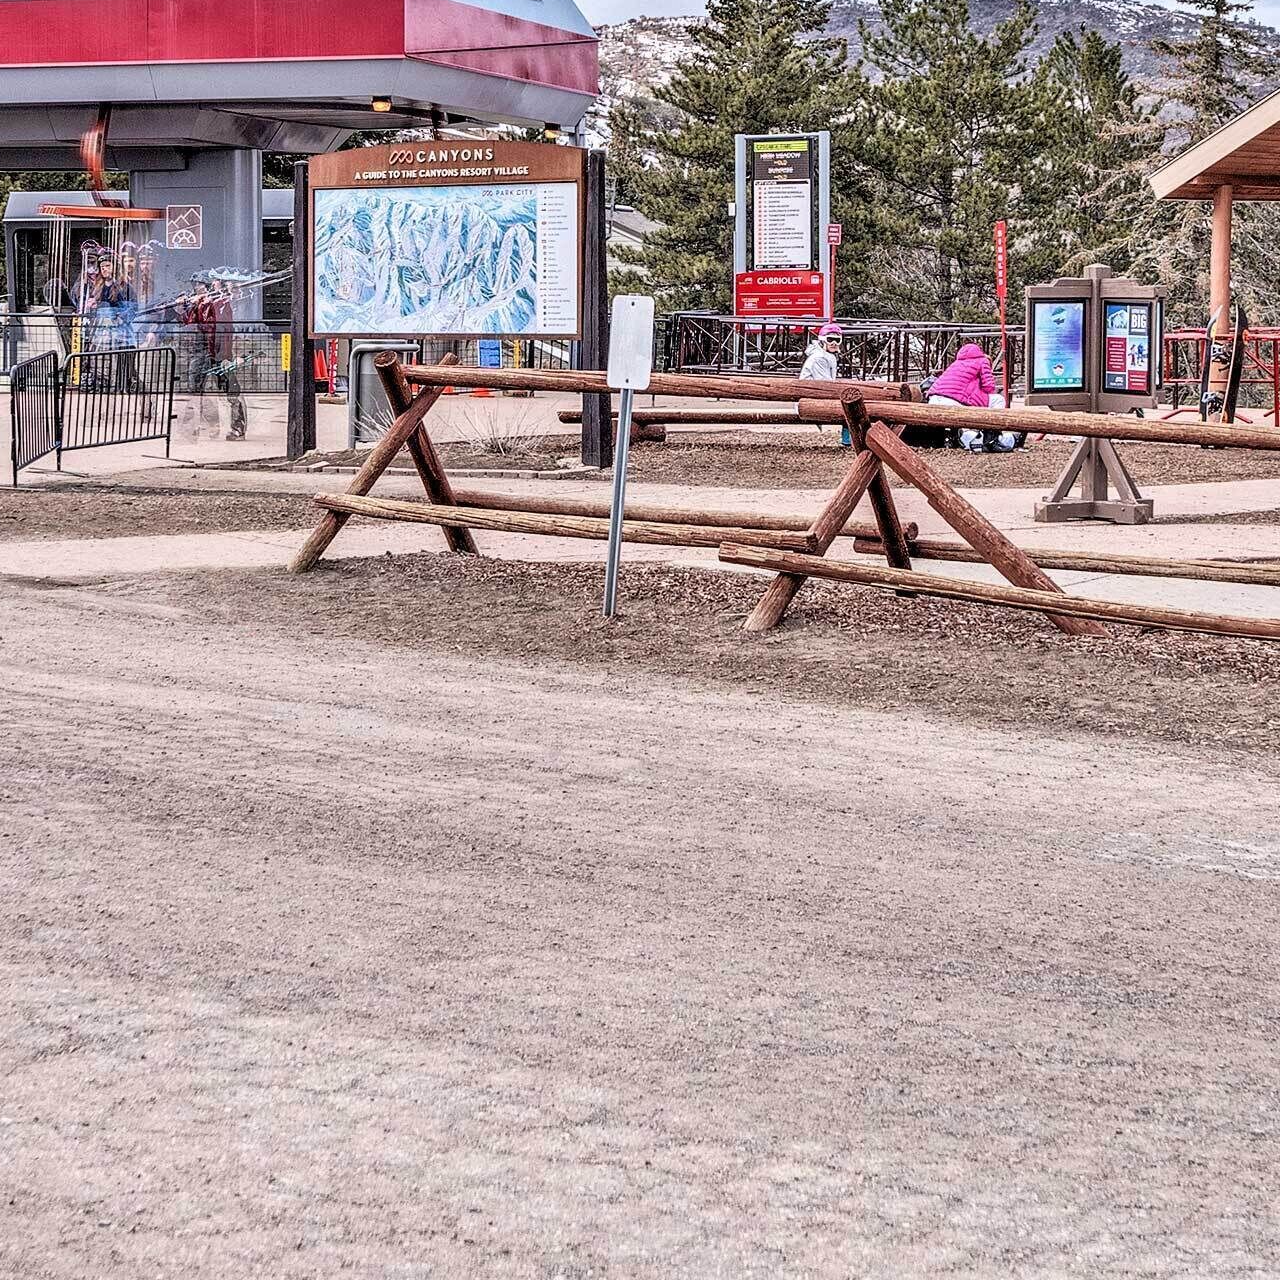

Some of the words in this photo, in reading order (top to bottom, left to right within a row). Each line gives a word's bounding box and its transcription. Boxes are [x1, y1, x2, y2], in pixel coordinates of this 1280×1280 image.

[416, 148, 494, 163] CANYONS
[362, 172, 387, 180] GUIDE
[389, 171, 401, 179] TO
[418, 169, 459, 178] CANYONS
[460, 168, 492, 176] RESORT
[494, 166, 529, 175] VILLAGE
[756, 277, 803, 285] CABRIOLET
[1131, 314, 1147, 328] BIG
